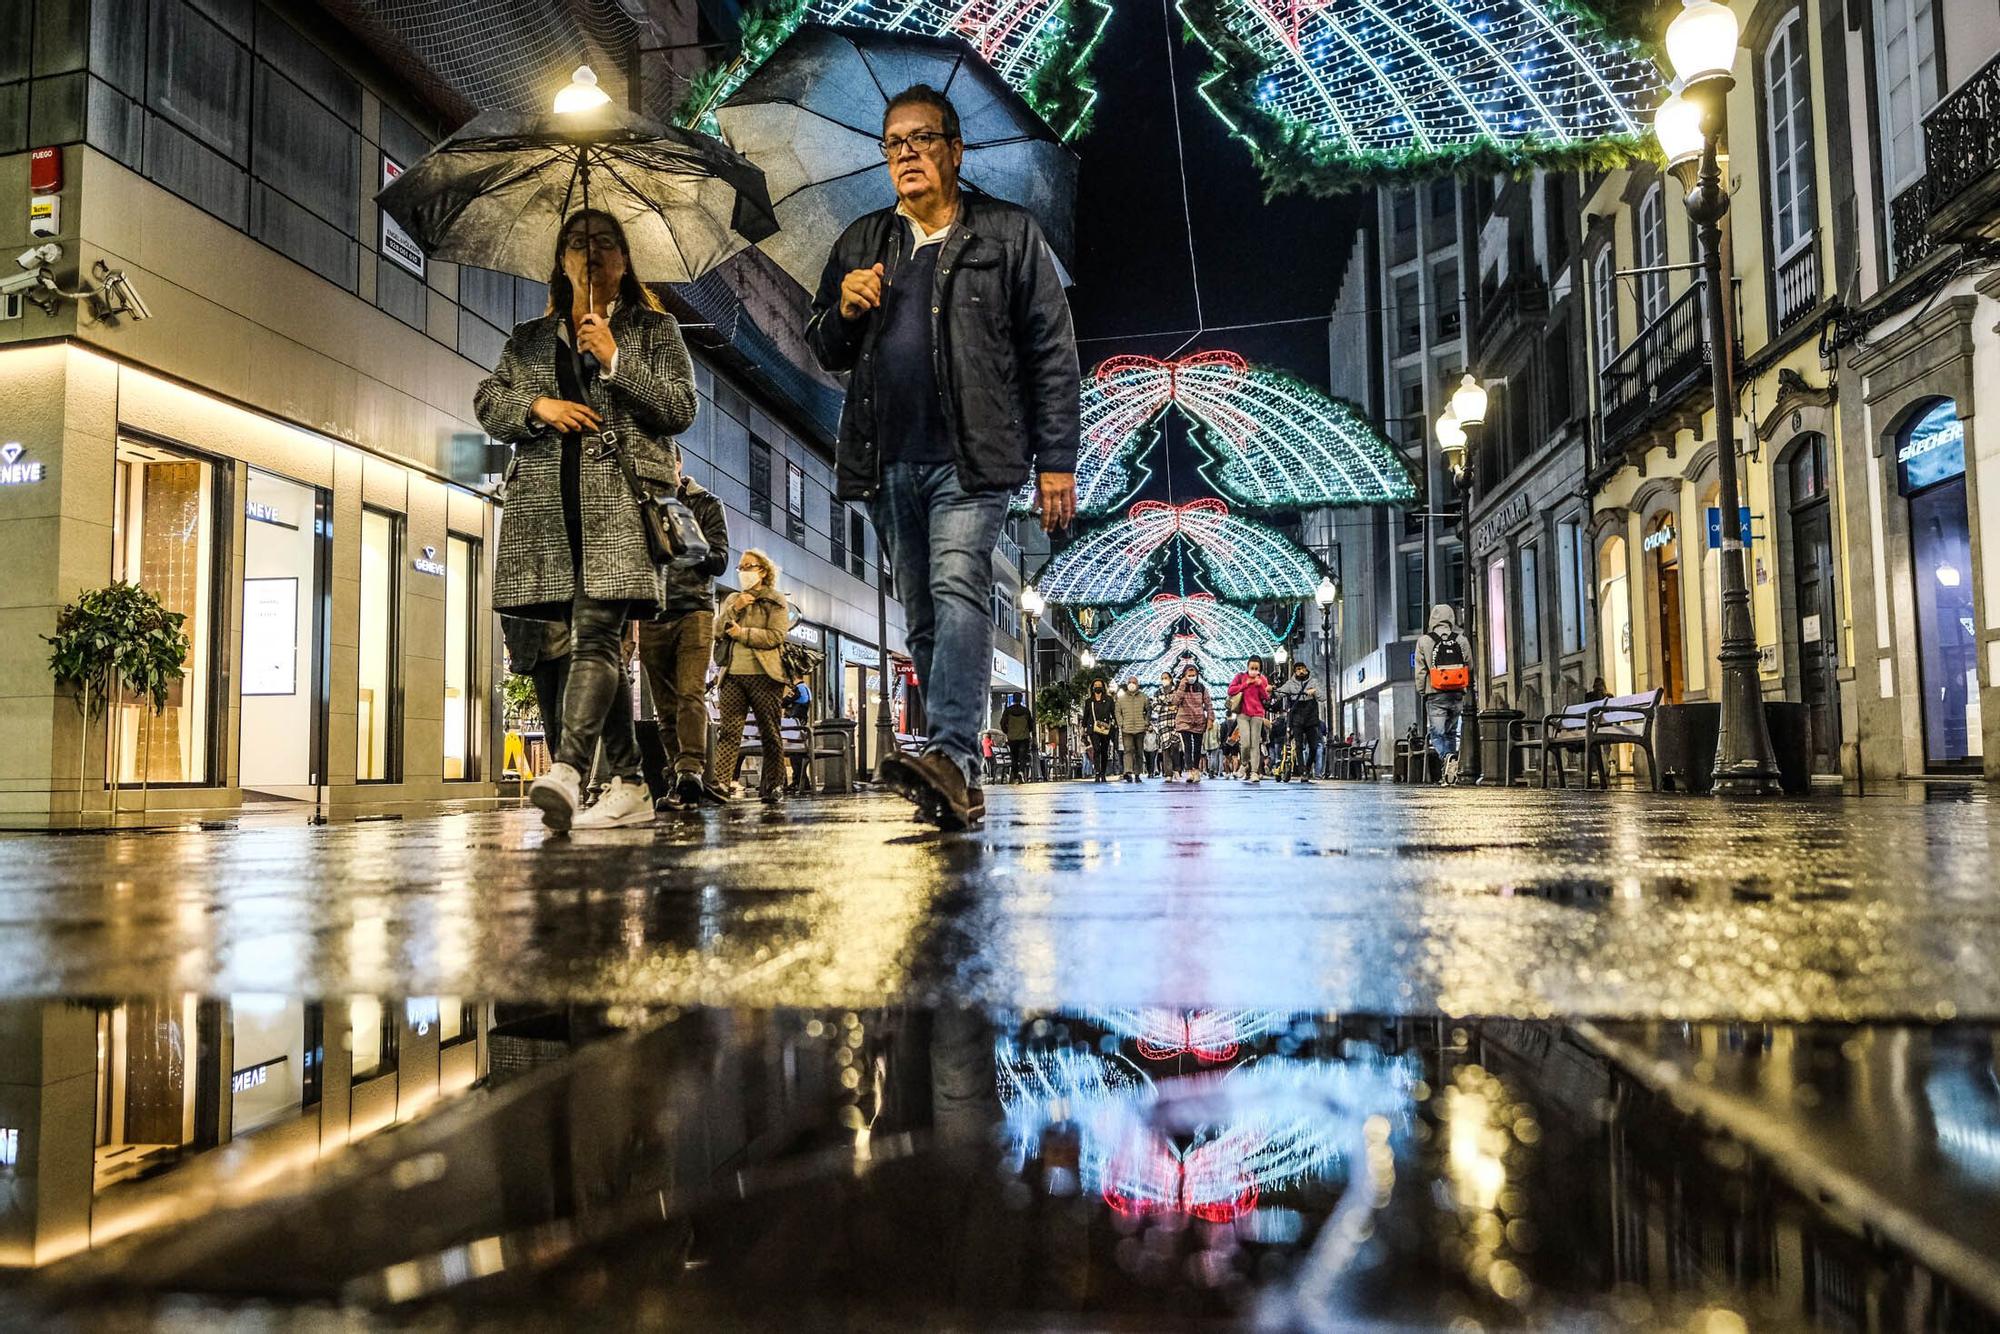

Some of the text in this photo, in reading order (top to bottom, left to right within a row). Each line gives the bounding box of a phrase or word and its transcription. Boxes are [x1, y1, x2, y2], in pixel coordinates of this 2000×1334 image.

[32, 150, 53, 159] FUEGO
[0, 462, 41, 482] NEVE
[246, 500, 280, 522] NEVE
[415, 559, 446, 576] GENEVE
